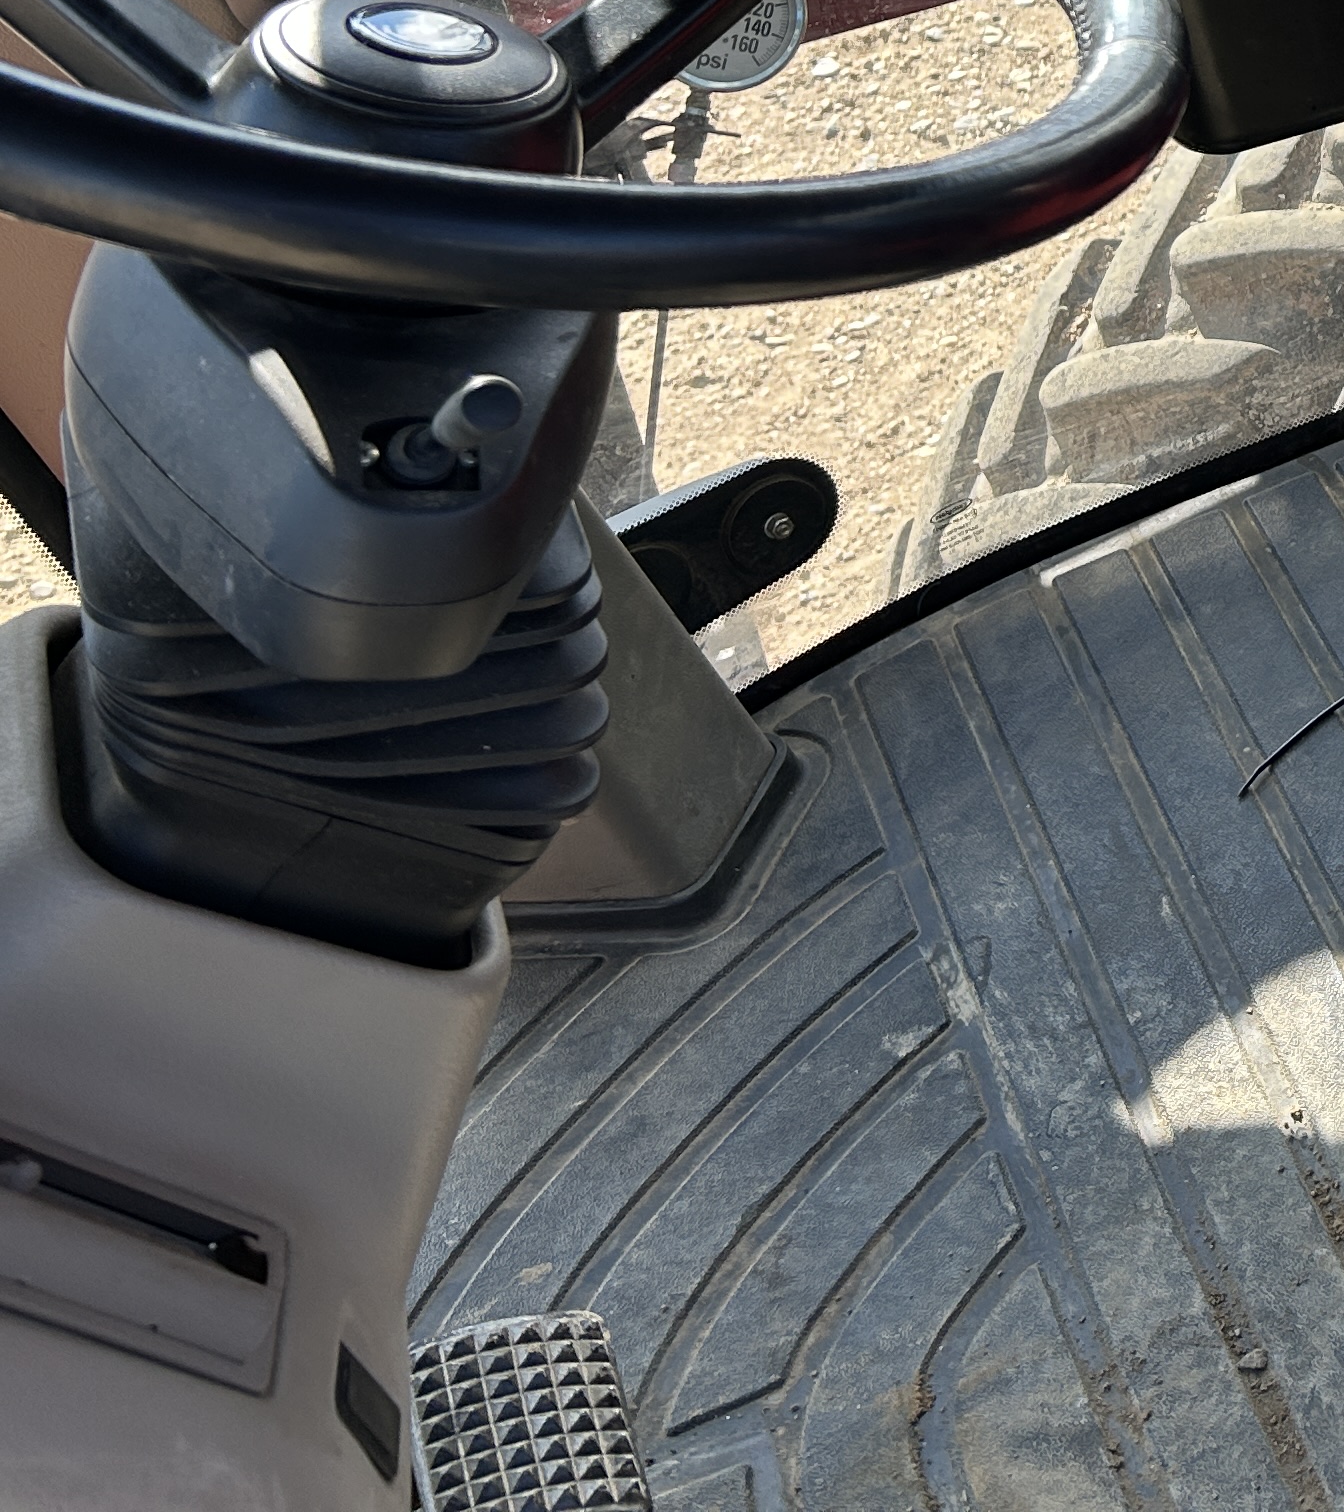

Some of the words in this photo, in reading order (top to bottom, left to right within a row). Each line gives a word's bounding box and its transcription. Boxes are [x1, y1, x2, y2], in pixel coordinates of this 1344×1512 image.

[748, 2, 774, 19] 20
[743, 17, 772, 37] 140
[731, 35, 759, 54] 160
[696, 53, 729, 70] psi
